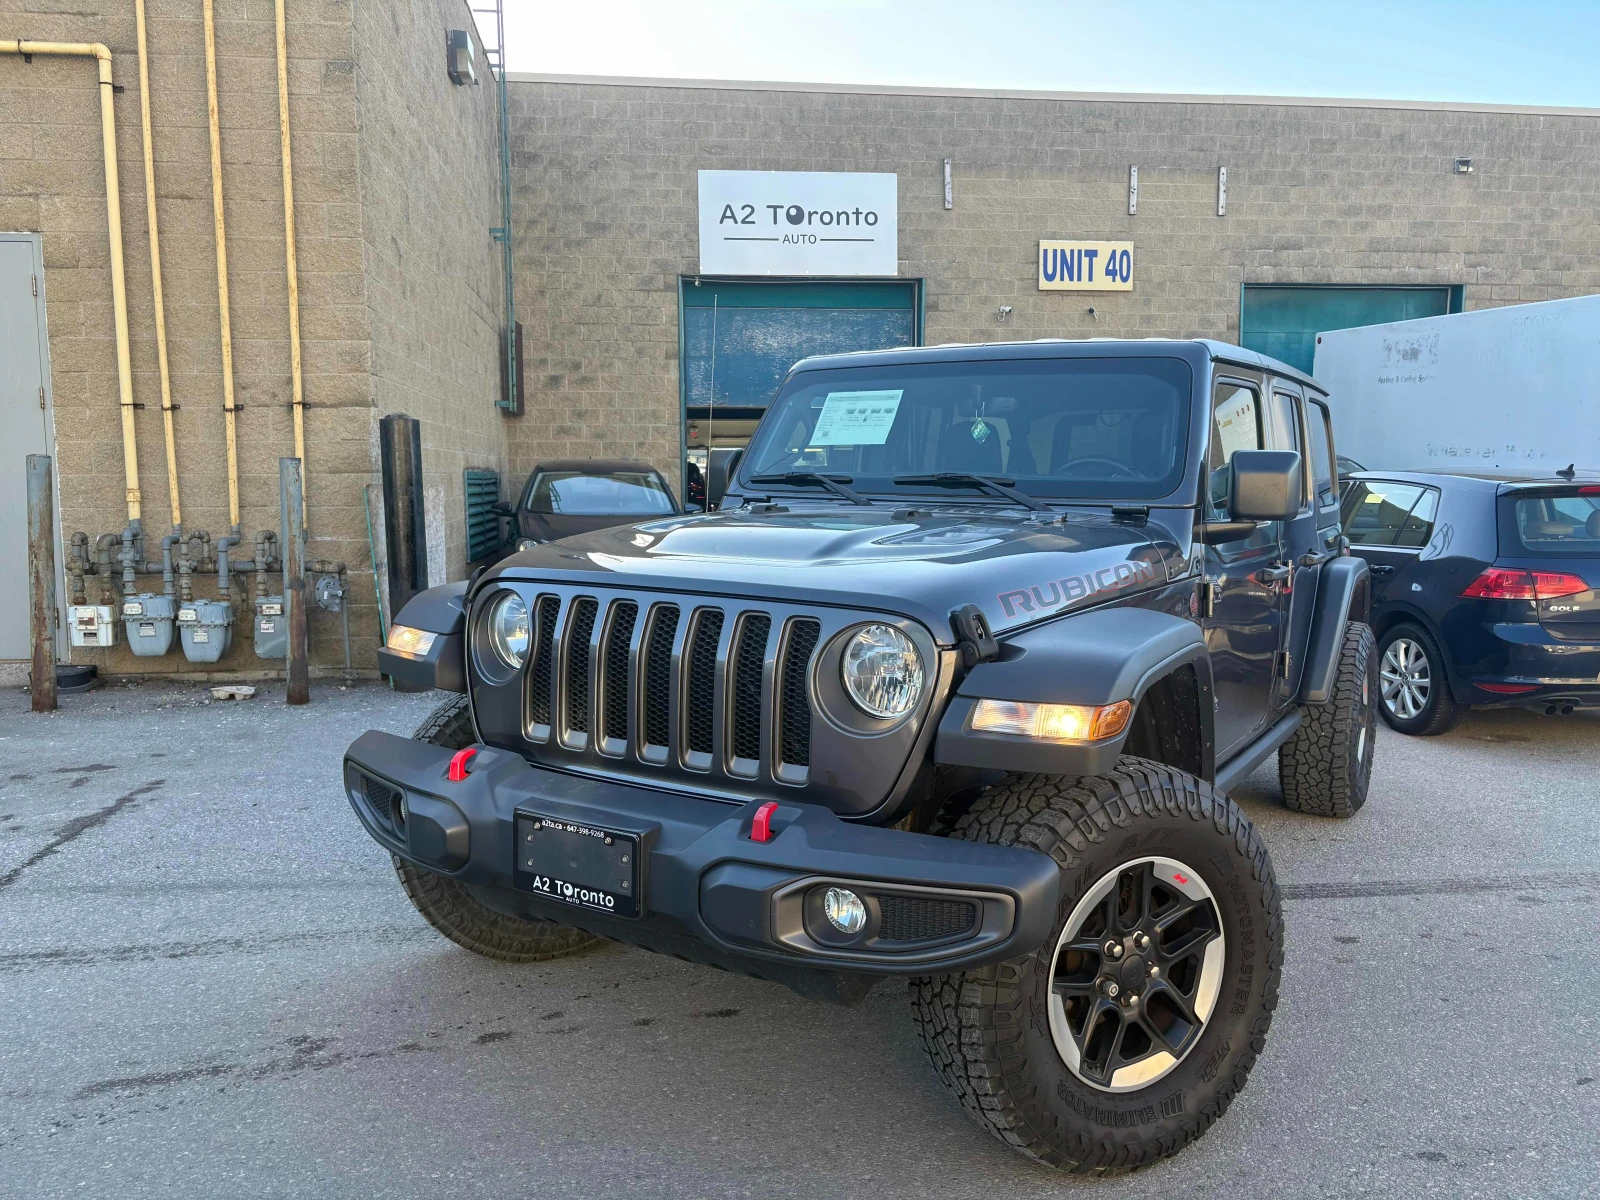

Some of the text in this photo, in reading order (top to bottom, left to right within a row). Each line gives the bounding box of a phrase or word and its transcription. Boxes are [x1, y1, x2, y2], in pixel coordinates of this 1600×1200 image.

[719, 203, 756, 226] A2
[782, 234, 818, 245] AUTO
[1042, 248, 1132, 284] UNIT 40
[997, 556, 1157, 620] RUBICON
[541, 819, 563, 831] a2ta.ca
[532, 875, 550, 892] A2
[565, 896, 580, 904] AUTO
[1226, 874, 1256, 1018] MOTOMASTER
[1057, 1084, 1158, 1128] ELIMINATOR
